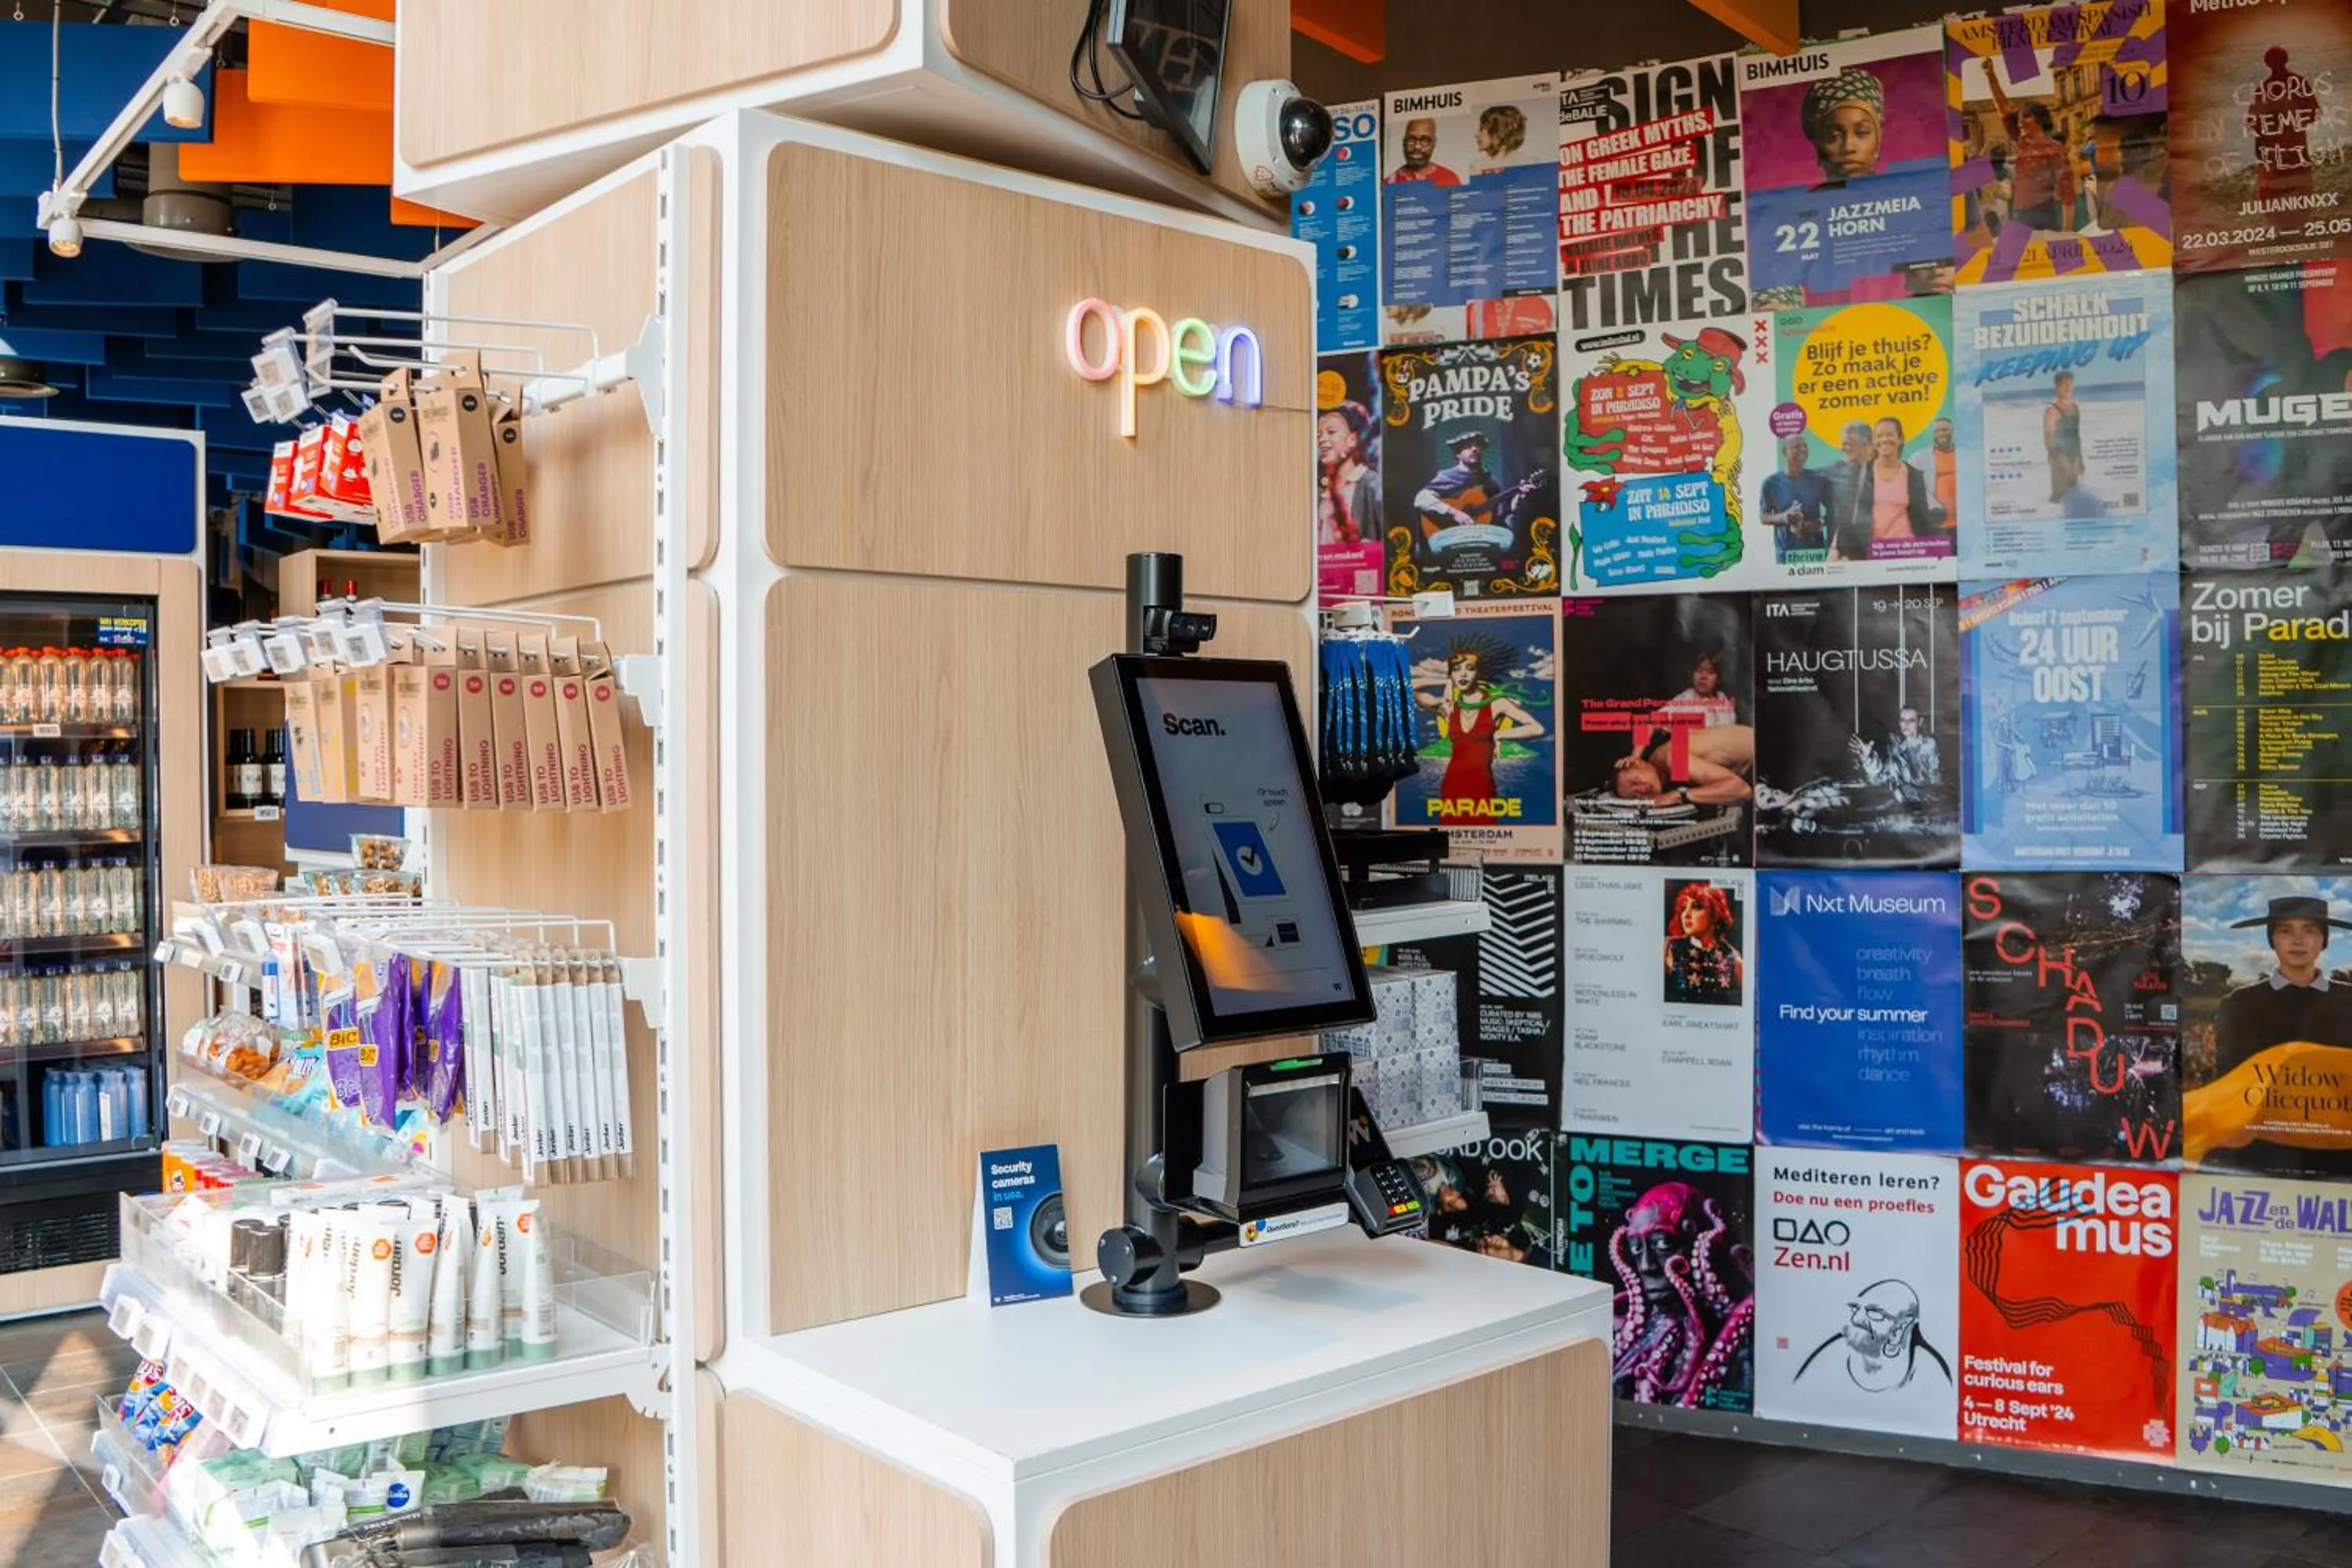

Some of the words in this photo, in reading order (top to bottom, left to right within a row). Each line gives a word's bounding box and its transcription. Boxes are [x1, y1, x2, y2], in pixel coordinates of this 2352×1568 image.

[1746, 53, 1830, 80] BIMHUIS
[1392, 92, 1464, 114] BIMHUIS
[1595, 56, 1738, 136] SIGN
[1559, 143, 1584, 166] ON
[1585, 125, 1642, 160] GREEK
[1559, 165, 1586, 188] THE
[1588, 155, 1649, 185] FEMALE
[1559, 188, 1599, 214] AND
[1827, 196, 1922, 222] JAZZMEIA
[2238, 192, 2339, 216] JULIANKNXX
[1559, 211, 1597, 237] THE
[1600, 194, 1723, 232] PATRIARCHY
[1828, 217, 1886, 238] HORN
[1774, 221, 1820, 252] 22
[2182, 226, 2277, 249] 22.03.2024
[1563, 256, 1747, 330] TIMES
[2012, 291, 2111, 322] SCHALK
[1973, 314, 2151, 350] BEZUIDENHOUT
[1806, 340, 1844, 362] Blijf
[1849, 341, 1867, 361] je
[1872, 332, 1933, 354] thuis?
[1065, 296, 1263, 437] open
[1812, 361, 1838, 377] Zo
[1842, 357, 1896, 375] maak
[1902, 354, 1922, 372] je
[1590, 388, 1613, 401] ZON
[1627, 383, 1657, 397] SEPT
[1797, 381, 1818, 394] er
[1821, 378, 1860, 393] een
[1864, 369, 1939, 389] actieve
[1590, 402, 1603, 416] IN
[1606, 397, 1661, 415] PARADISO
[1817, 394, 1882, 410] zomer
[1886, 385, 1930, 405] van!
[1423, 394, 1514, 430] PRIDE
[1772, 410, 1804, 421] Gratis
[1626, 488, 1653, 505] ZAT
[1675, 481, 1709, 499] SEPT
[1628, 506, 1642, 521] IN
[1646, 498, 1711, 521] PARADISO
[1788, 551, 1824, 566] thrive
[1465, 603, 1555, 615] THEATERFESTIVAL
[2191, 582, 2310, 612] Zomer
[1766, 603, 1791, 618] ITA
[2191, 614, 2231, 650] bij
[2019, 627, 2057, 666] 24
[2061, 624, 2120, 665] UUR
[1766, 648, 1929, 673] HAUGTUSSA
[2032, 664, 2107, 705] OOST
[1163, 713, 1226, 736] Scan.
[1427, 797, 1523, 818] PARADE
[1449, 828, 1514, 840] MSTERDAM
[1806, 895, 1846, 913] Nxt
[1848, 894, 1947, 914] Museum
[1856, 946, 1933, 964] creativity
[1857, 965, 1912, 982] breath
[1857, 985, 1894, 1001] flow
[1779, 1004, 1816, 1020] Find
[1816, 1007, 1855, 1025] your
[1857, 1007, 1929, 1024] summer
[1857, 1025, 1944, 1047] inspiration
[1857, 1046, 1920, 1065] rhythm
[1857, 1065, 1911, 1083] dance
[2252, 1063, 2340, 1089] Widow
[2243, 1086, 2352, 1121] Clicquot
[1487, 1137, 1544, 1162] OOK
[1570, 1137, 1749, 1174] MERGE
[990, 1160, 1033, 1175] Security
[1773, 1166, 1872, 1187] Mediteren
[1878, 1173, 1940, 1190] leren?
[991, 1174, 1036, 1189] cameras
[1964, 1163, 2172, 1218] Gaudea
[993, 1191, 1004, 1202] in
[1773, 1190, 1805, 1205] Doe
[1809, 1195, 1829, 1207] nu
[1834, 1198, 1864, 1210] een
[1867, 1197, 1935, 1214] proefles
[2198, 1186, 2274, 1226] JAZZ
[2269, 1204, 2290, 1216] en
[2274, 1217, 2296, 1230] de
[2056, 1214, 2173, 1258] mus
[1773, 1246, 1851, 1272] Zen.nl
[1964, 1355, 2027, 1375] Festival
[2029, 1360, 2054, 1378] for
[1964, 1373, 2024, 1392] curious
[2027, 1379, 2064, 1396] ears
[1963, 1395, 1974, 1410] 4
[1994, 1398, 2005, 1411] 8
[2009, 1401, 2048, 1421] Sept
[1964, 1410, 2027, 1432] Utrecht
